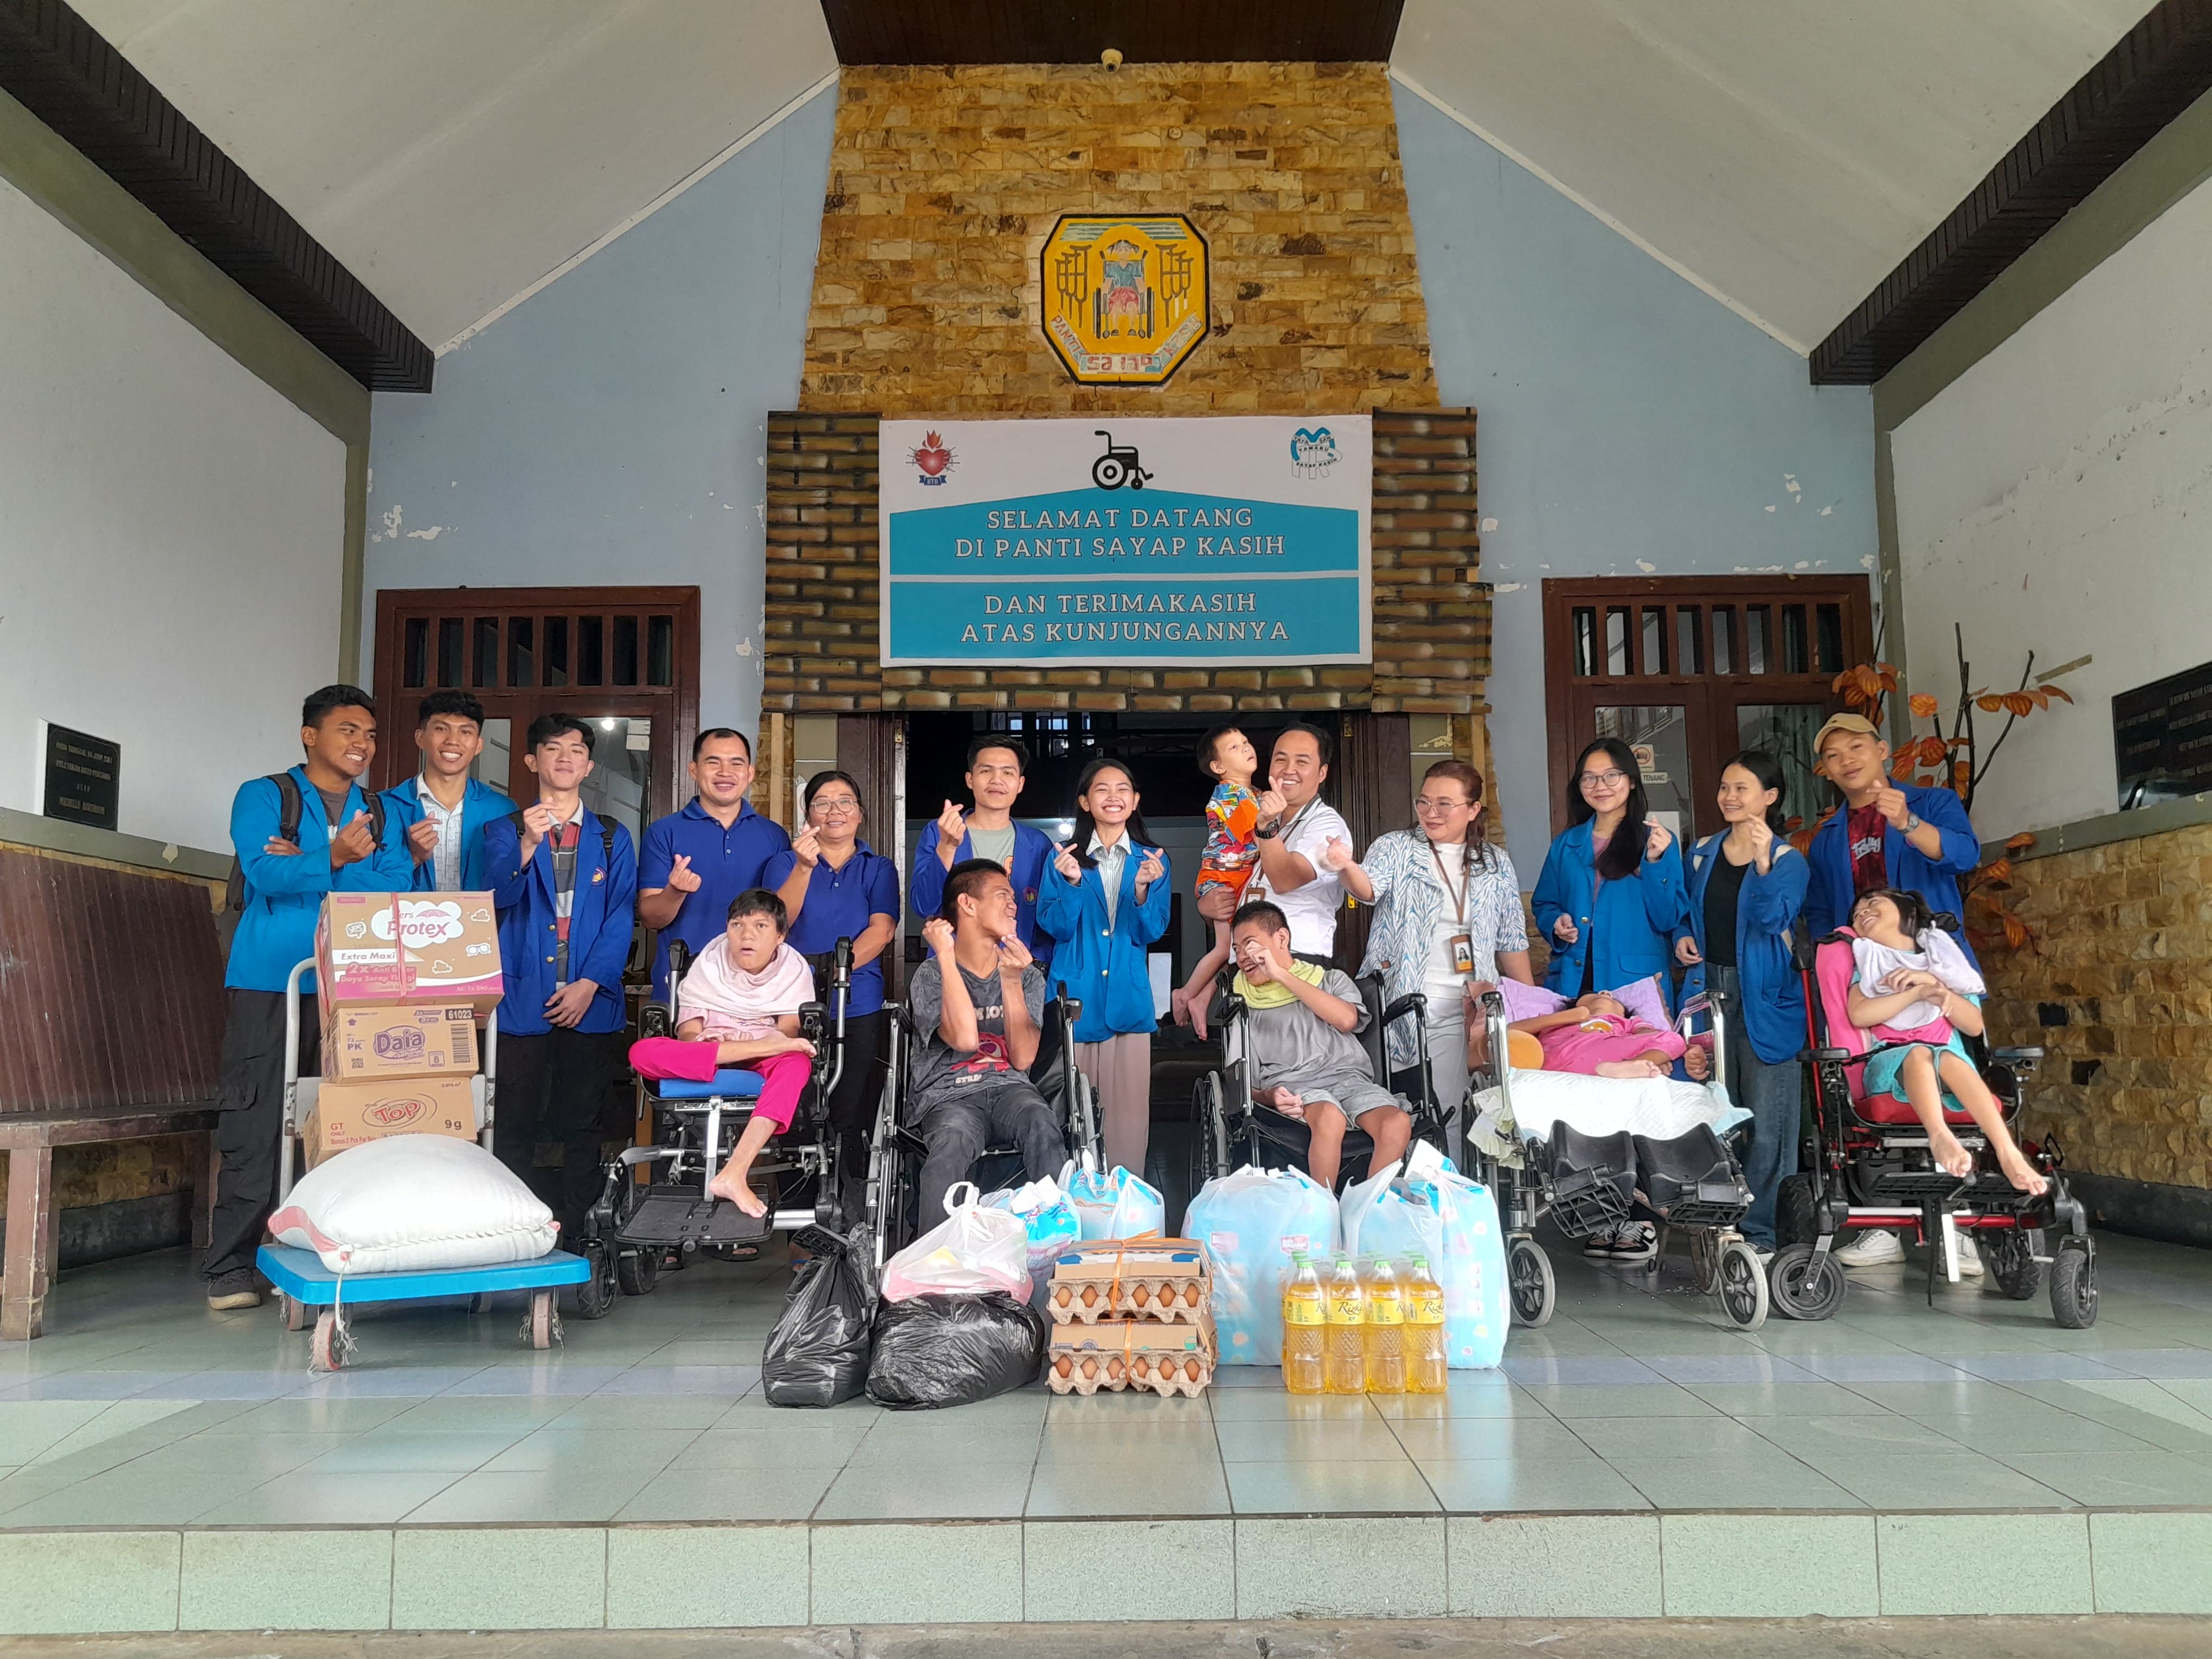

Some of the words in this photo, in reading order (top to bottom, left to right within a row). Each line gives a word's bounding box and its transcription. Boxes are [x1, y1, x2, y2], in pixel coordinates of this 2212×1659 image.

[1051, 313, 1081, 353] PANTI
[987, 509, 1121, 529] SELAMAT
[1130, 507, 1252, 528] DATANG
[955, 538, 985, 558] DI
[994, 537, 1083, 558] PANTI
[1092, 537, 1187, 557] SAYAP
[1197, 535, 1285, 556] KASIH
[984, 595, 1047, 614] DAN
[1056, 593, 1257, 614] TERIMAKASIH
[960, 623, 1036, 642] ATAS
[1045, 621, 1290, 642] KUNJUNGANNYA
[387, 921, 451, 938] Protex
[448, 1009, 472, 1019] 61023
[375, 1029, 423, 1054] Daia
